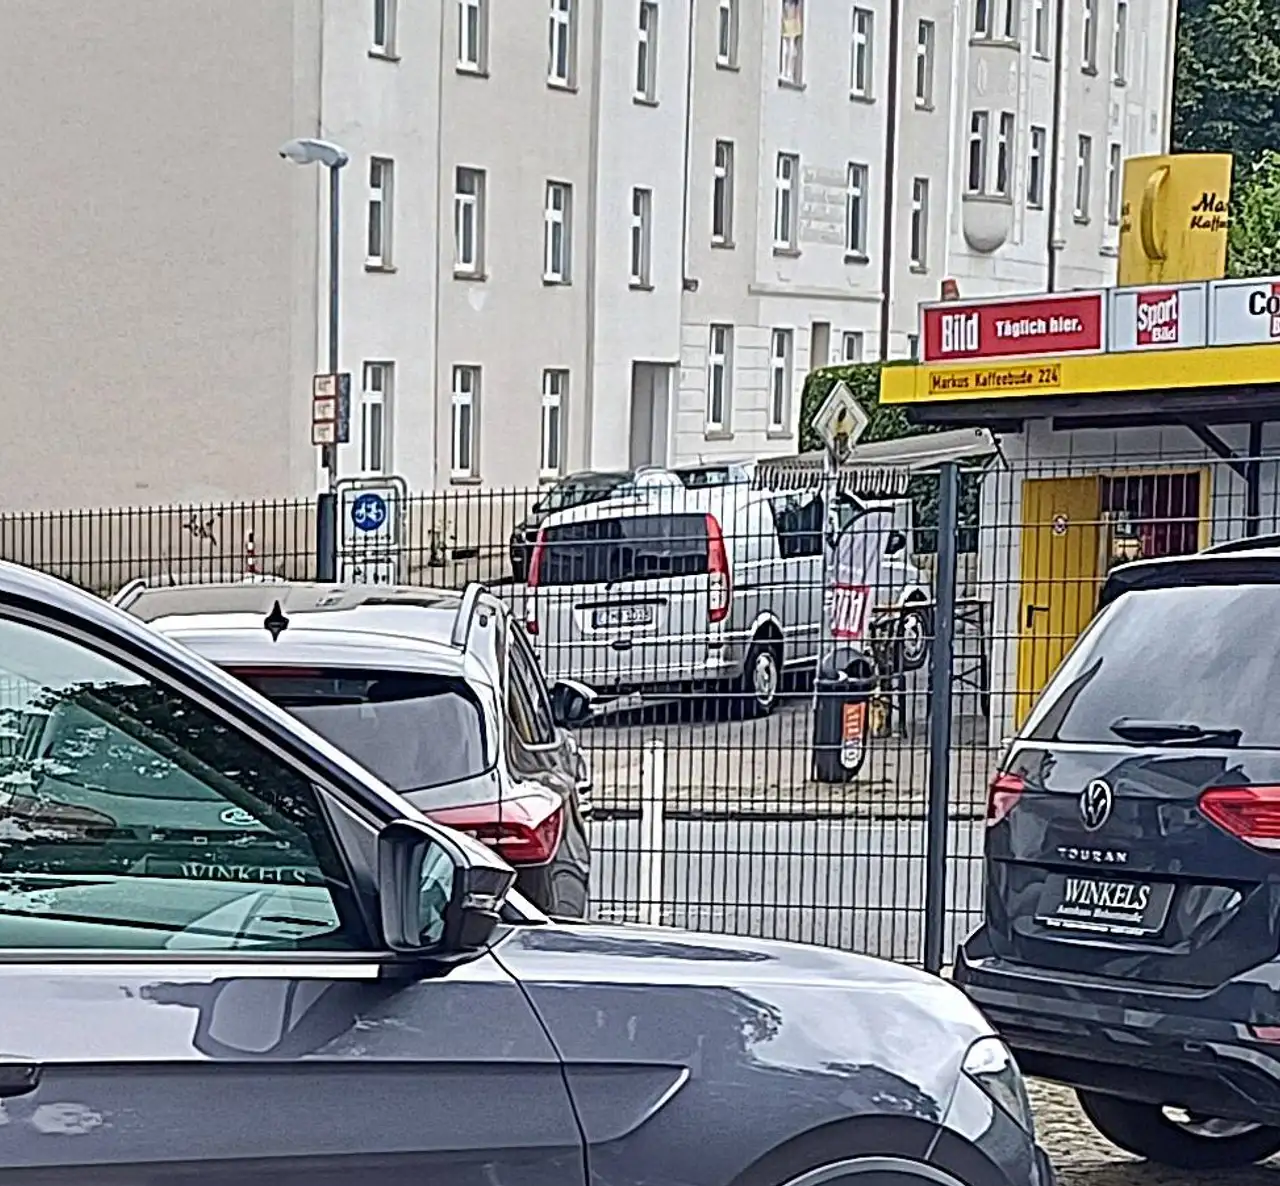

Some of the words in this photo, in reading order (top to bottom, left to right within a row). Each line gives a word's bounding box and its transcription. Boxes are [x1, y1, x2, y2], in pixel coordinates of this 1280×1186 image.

[1138, 292, 1178, 331] Sport
[942, 312, 979, 353] Bild
[995, 318, 1046, 338] Täglich
[1049, 316, 1083, 333] hier.
[1151, 326, 1177, 342] Bild
[932, 374, 970, 390] Markus
[1065, 878, 1151, 911] WINKELS
